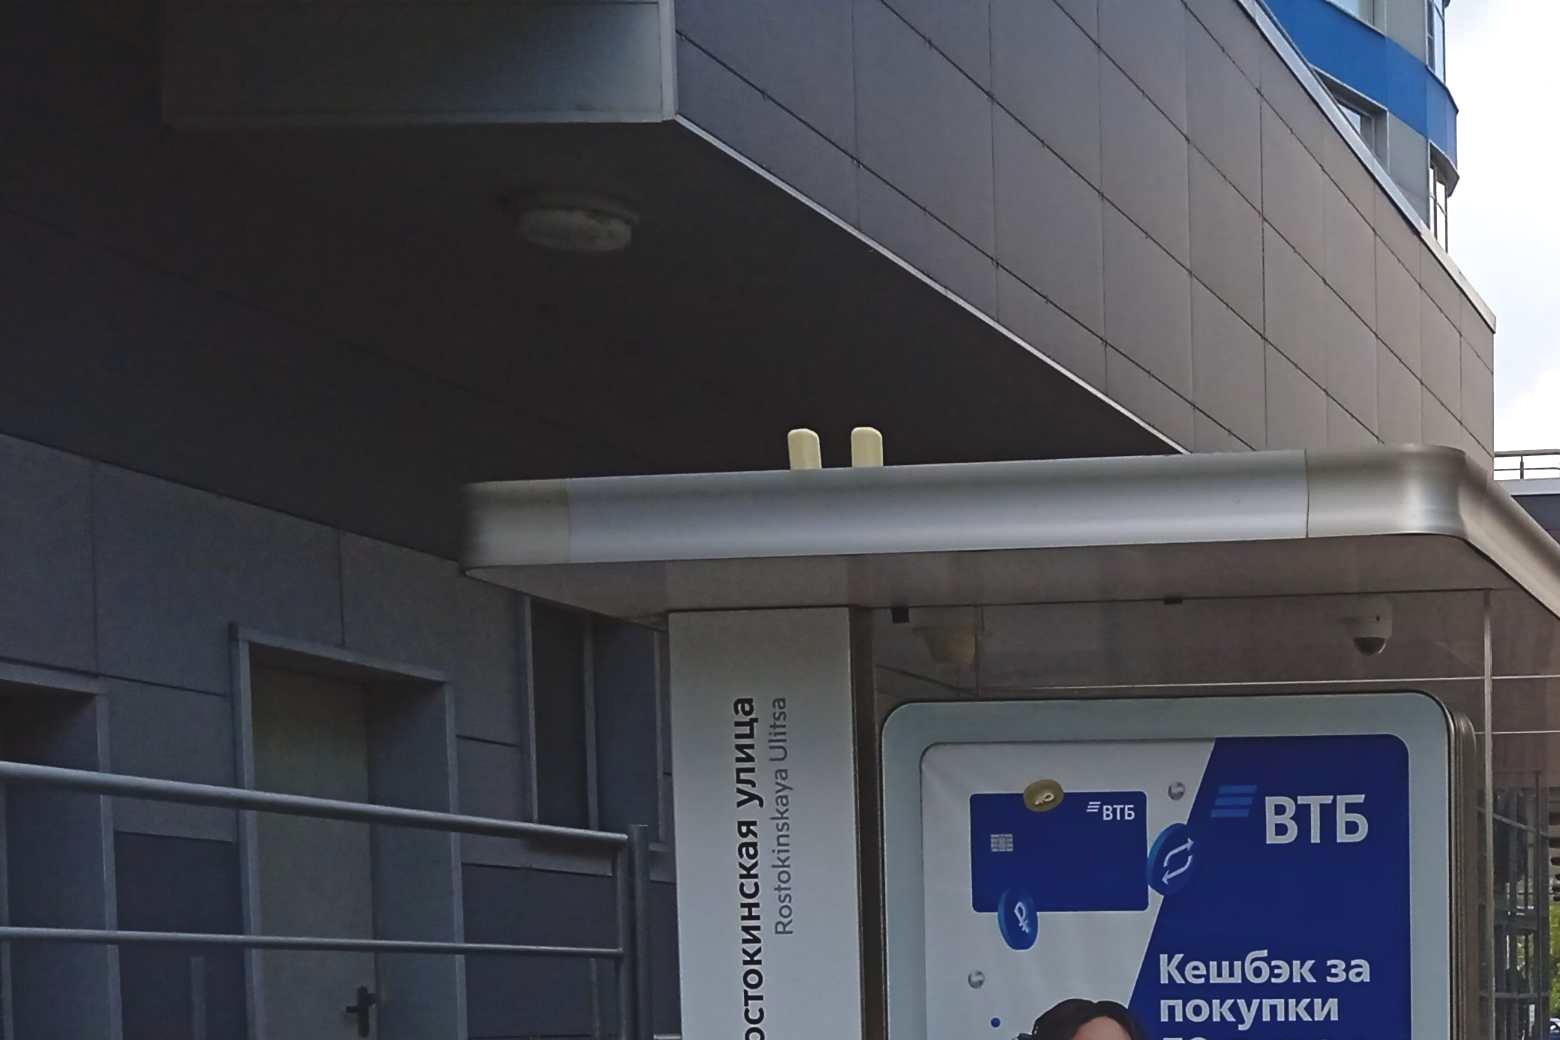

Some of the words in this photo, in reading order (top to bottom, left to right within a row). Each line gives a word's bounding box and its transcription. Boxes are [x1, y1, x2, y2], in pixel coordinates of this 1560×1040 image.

[731, 696, 764, 809] улица
[767, 696, 788, 762] Ulitsa
[1101, 803, 1136, 822] ВТБ
[1264, 793, 1370, 845] ВТБ
[769, 767, 795, 936] Rostokinskaya
[1159, 949, 1316, 986] Кешбэк
[1325, 957, 1372, 984] за
[1159, 994, 1339, 1032] покупки
